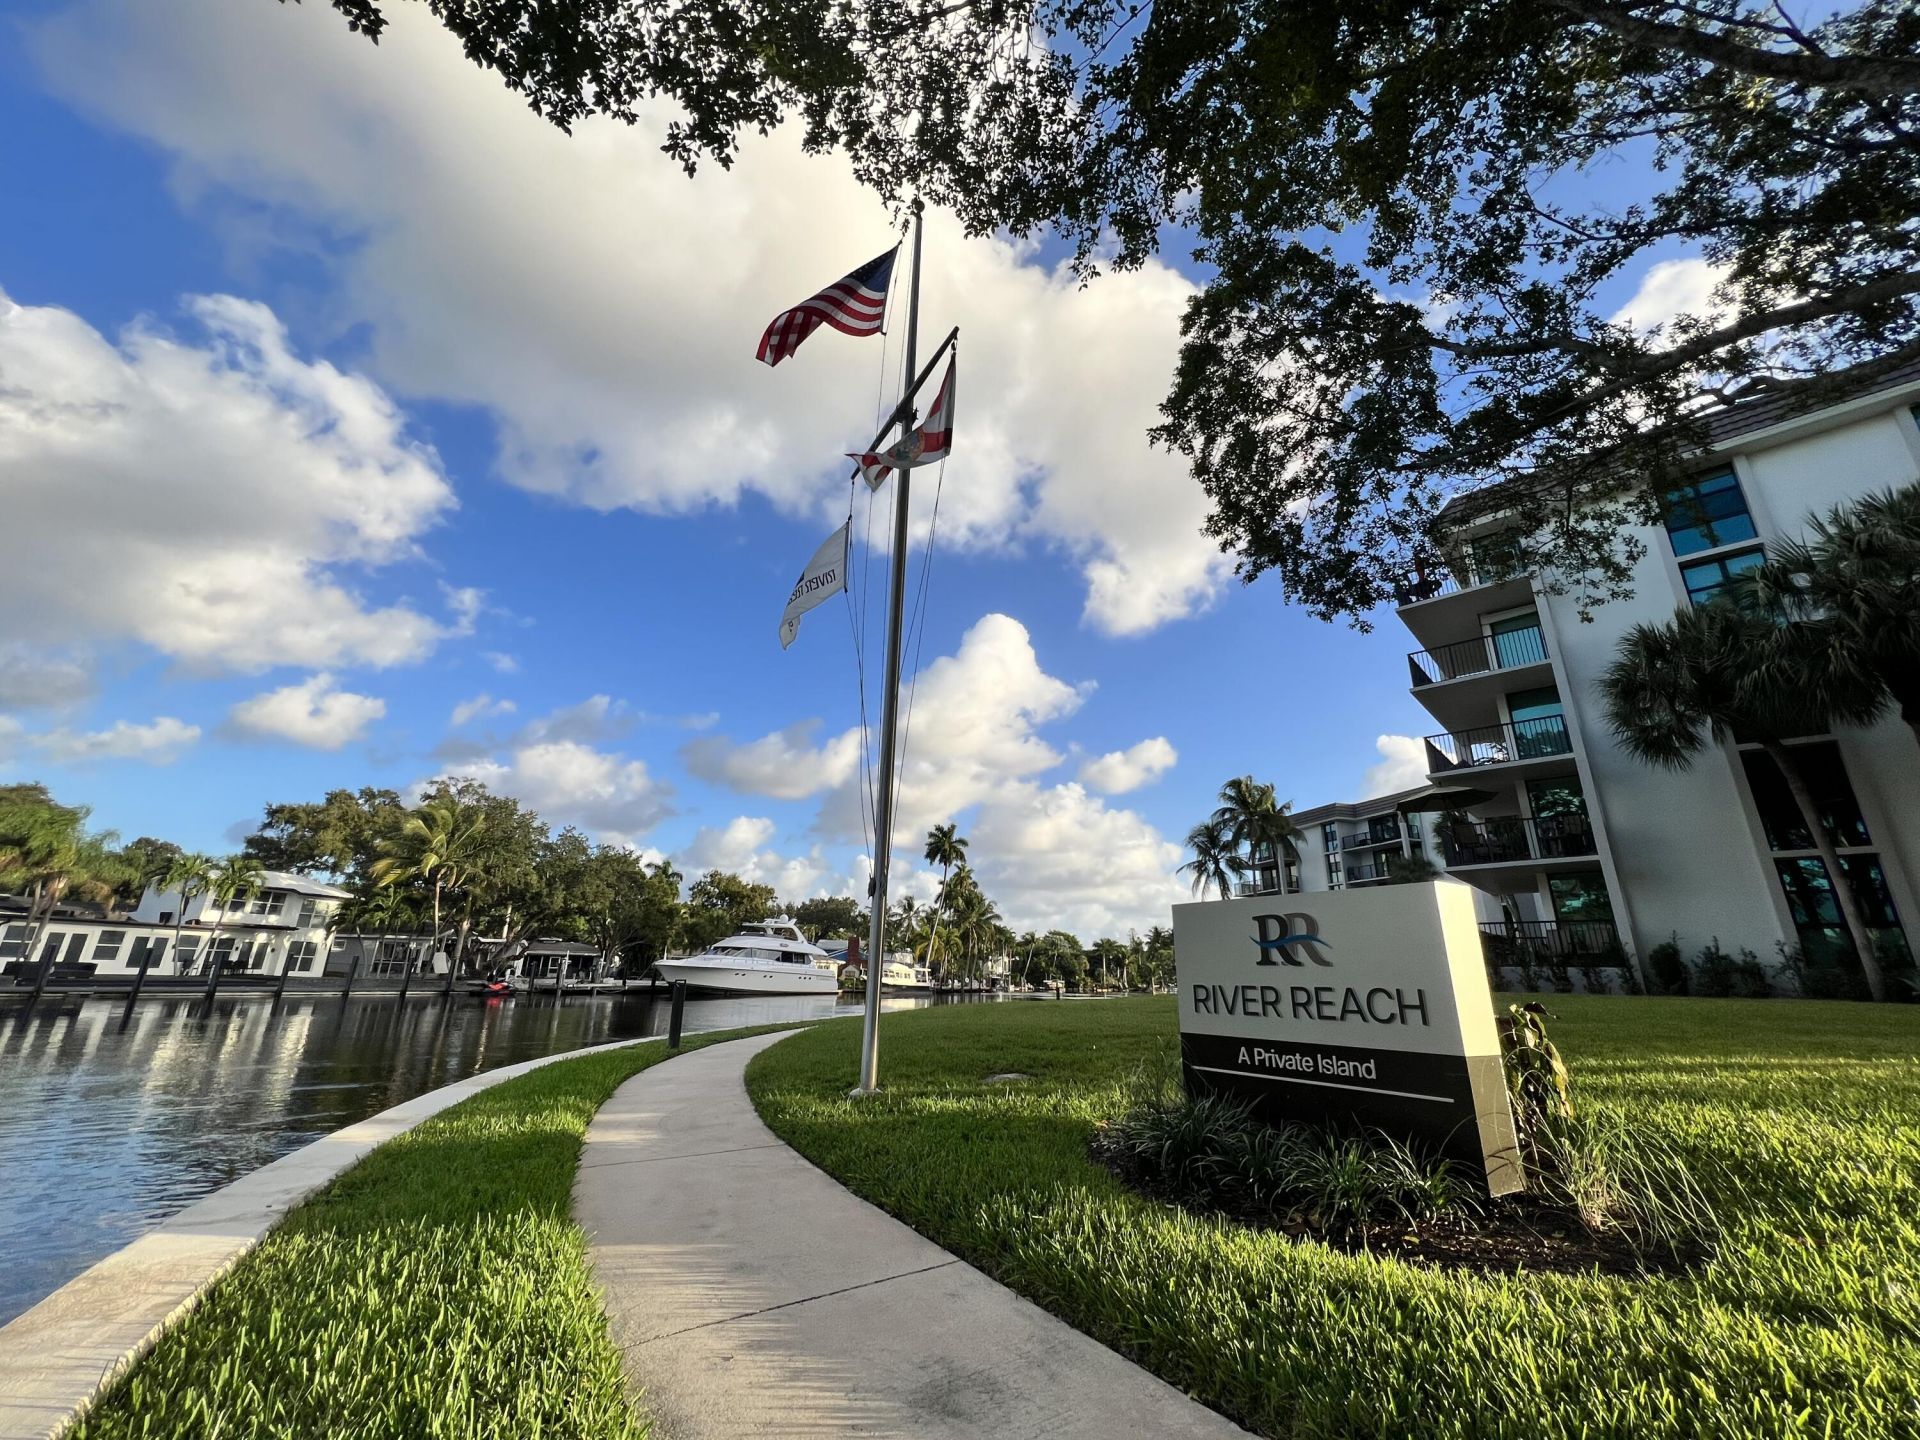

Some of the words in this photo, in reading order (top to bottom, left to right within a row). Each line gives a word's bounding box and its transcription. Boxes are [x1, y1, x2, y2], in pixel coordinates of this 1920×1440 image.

[1250, 912, 1334, 968] RR
[1192, 984, 1283, 1019] RIVER
[1290, 986, 1431, 1027] REACH
[1238, 1046, 1251, 1066] A
[1254, 1048, 1315, 1073] Private
[1318, 1053, 1377, 1080] Island
